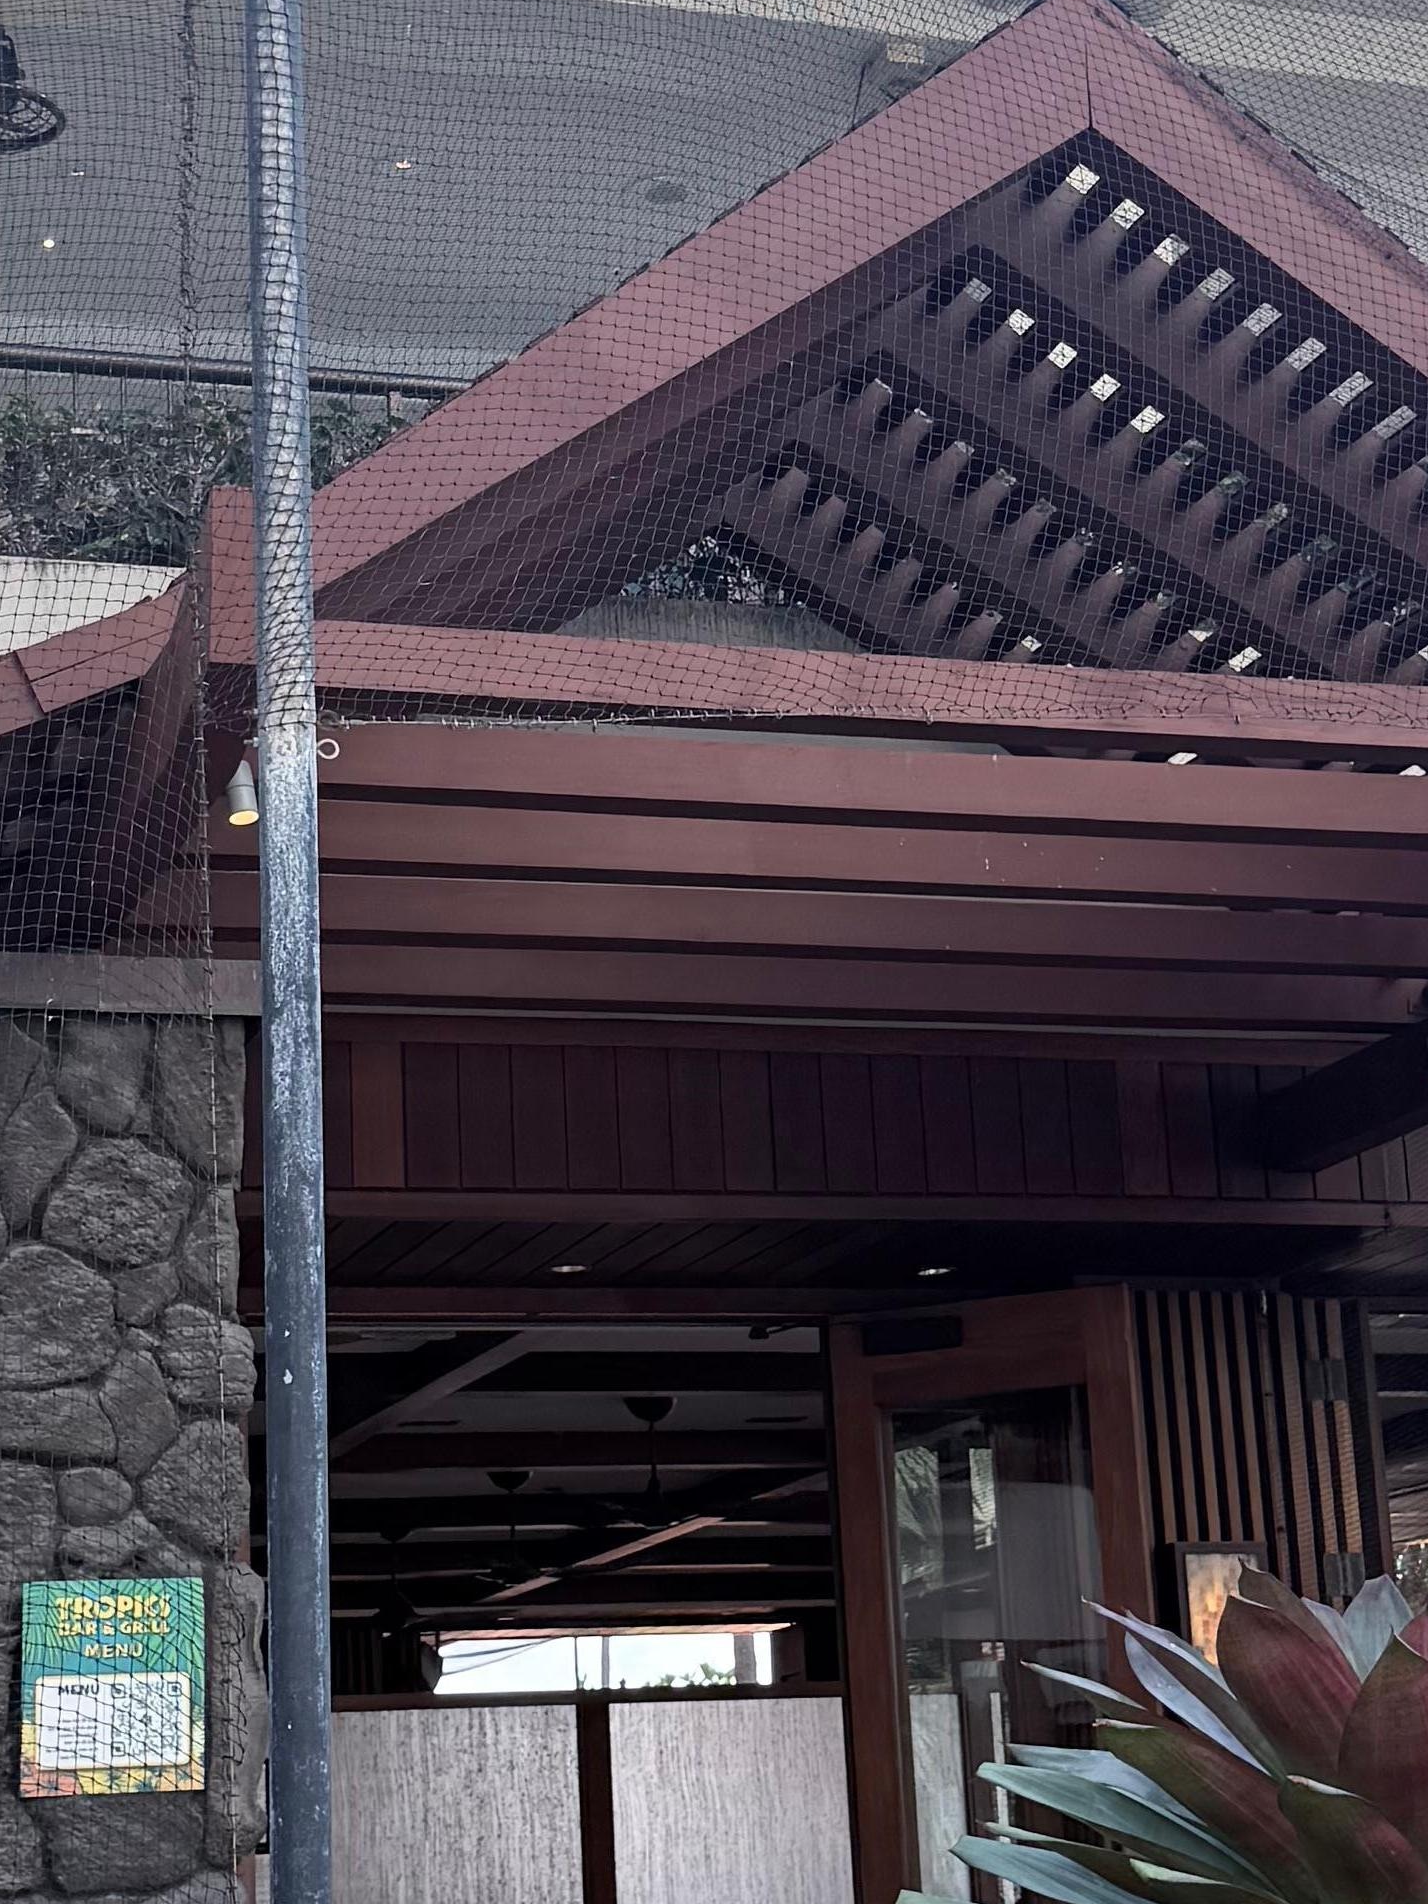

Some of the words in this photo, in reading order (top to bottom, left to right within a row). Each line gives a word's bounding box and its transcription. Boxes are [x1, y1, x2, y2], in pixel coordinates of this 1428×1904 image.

[55, 1594, 172, 1619] TROPICS
[58, 1621, 98, 1636] BAR
[119, 1620, 171, 1635] GRILL
[84, 1642, 143, 1658] MENU
[58, 1684, 100, 1696] MENU
